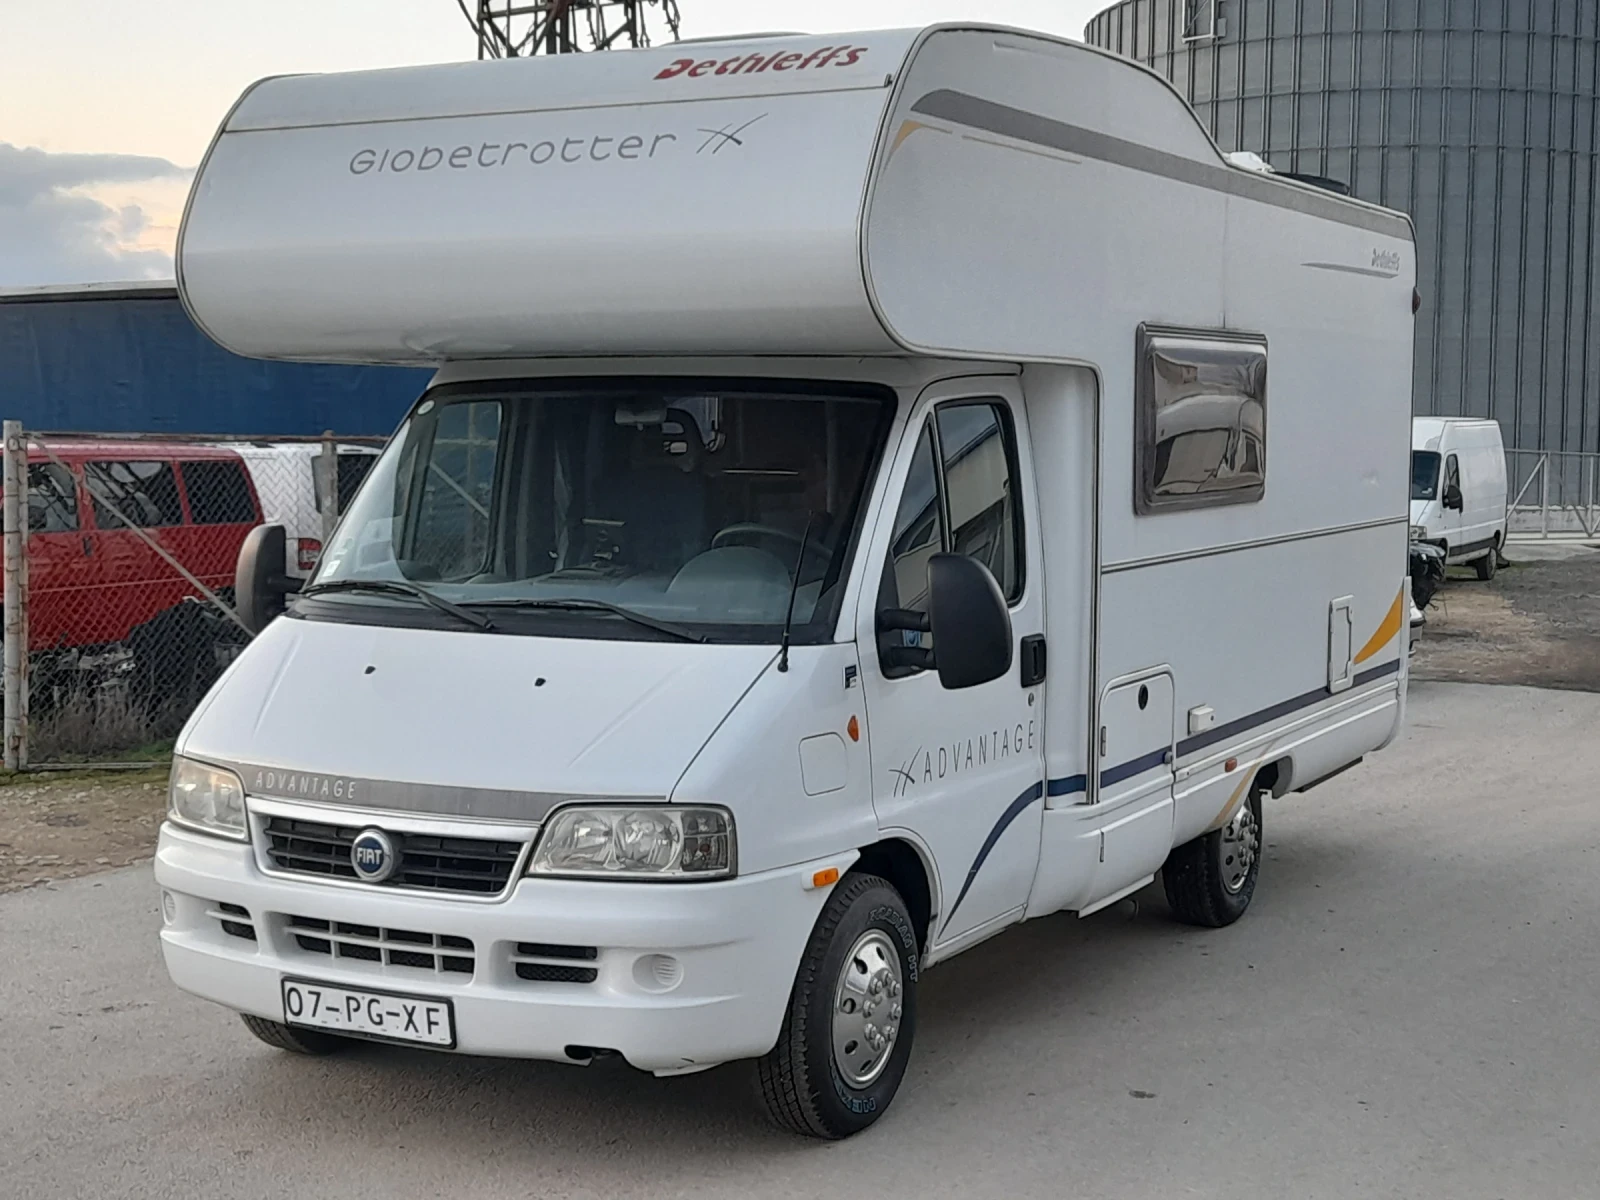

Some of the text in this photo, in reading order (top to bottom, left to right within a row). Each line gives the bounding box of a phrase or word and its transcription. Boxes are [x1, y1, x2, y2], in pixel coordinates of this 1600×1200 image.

[653, 44, 869, 81] Dethleffs
[350, 133, 677, 175] Globetrotter
[923, 719, 1035, 784] ADVANTAGE
[255, 771, 357, 799] ADVANTAGE
[356, 847, 382, 865] FIAT
[286, 986, 440, 1035] 07-PG-XF
